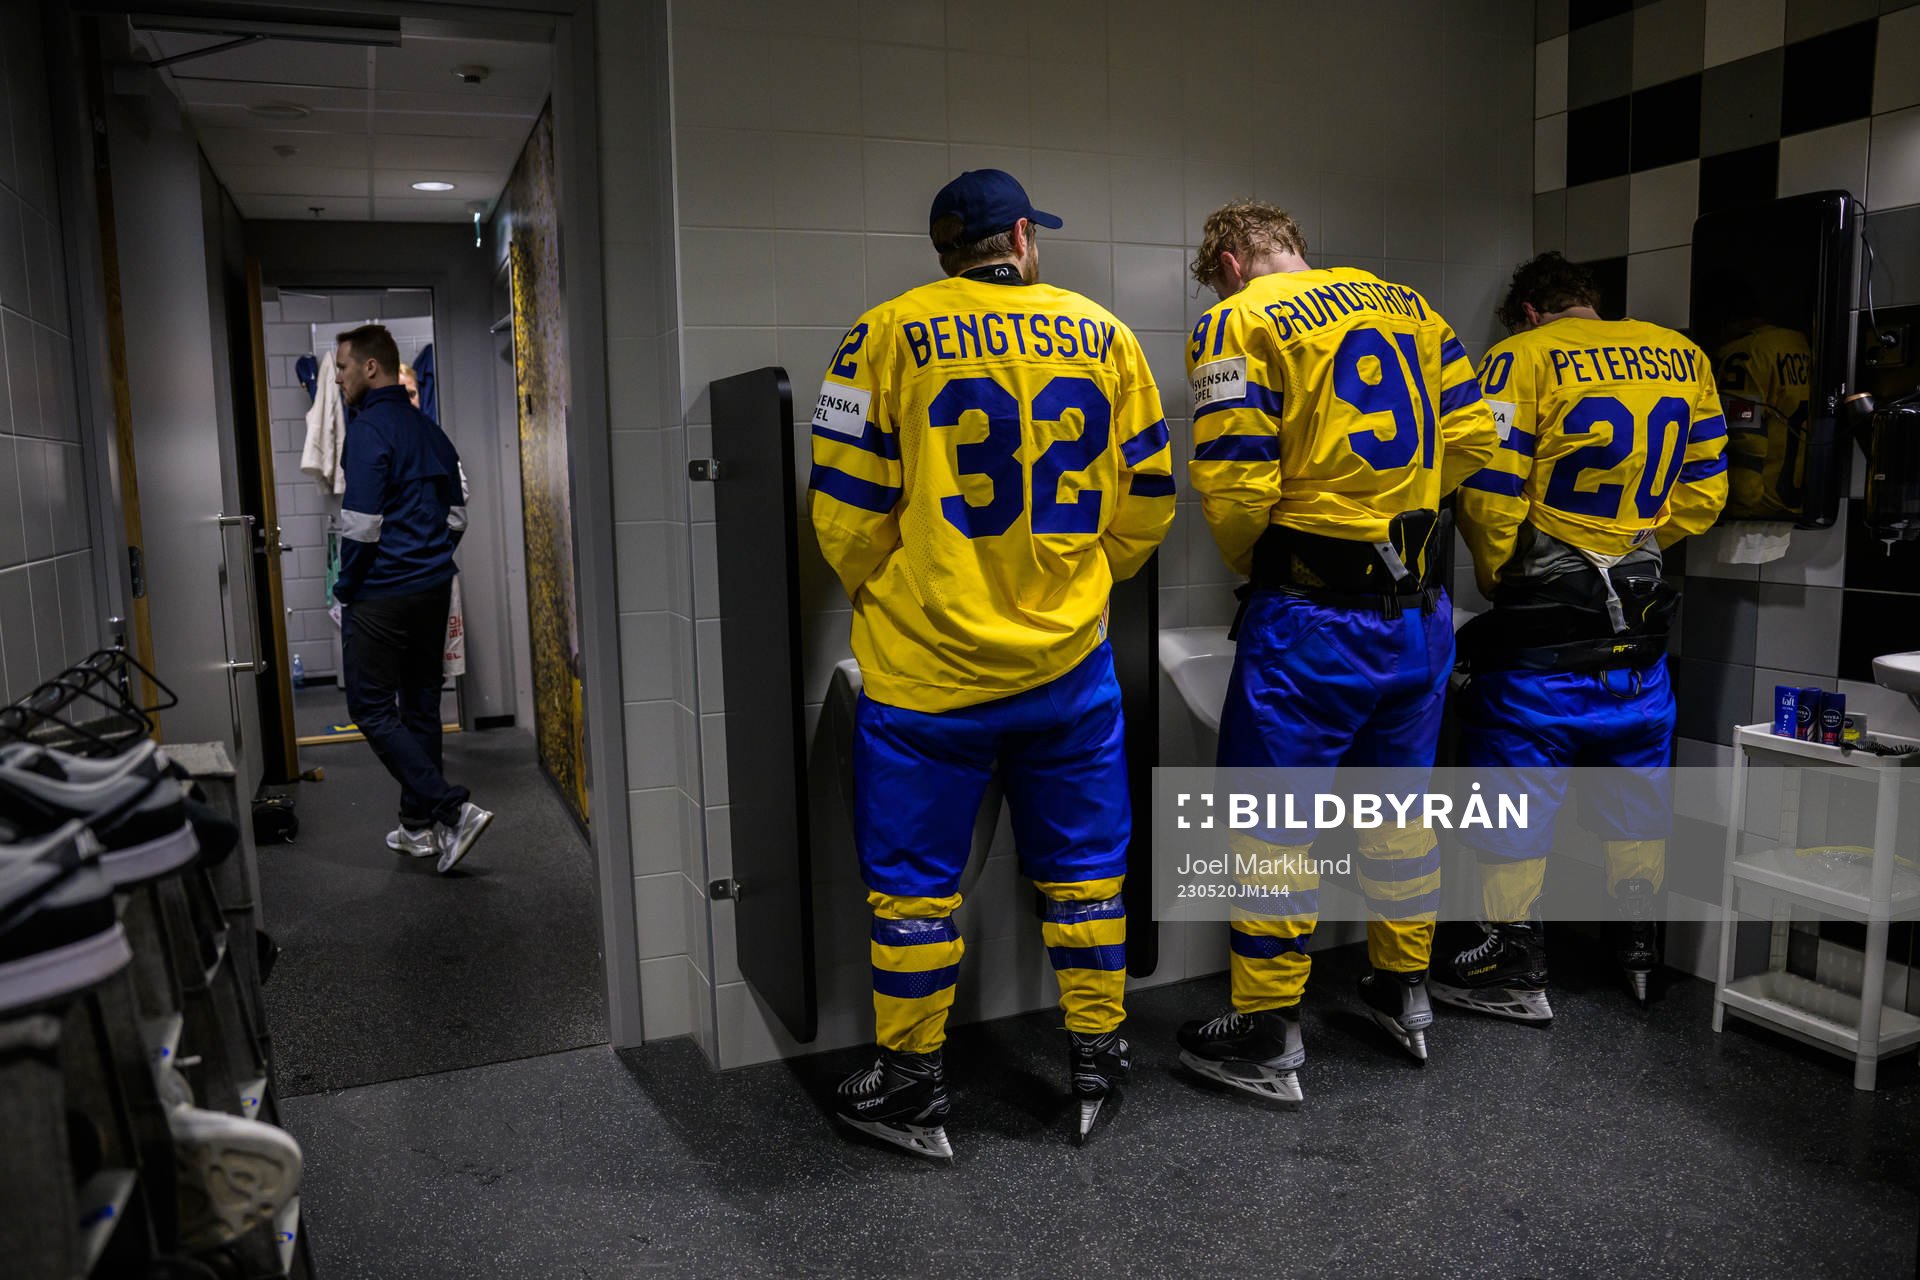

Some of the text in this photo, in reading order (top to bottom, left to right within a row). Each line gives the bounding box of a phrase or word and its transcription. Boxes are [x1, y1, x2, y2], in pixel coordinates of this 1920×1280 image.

[828, 322, 869, 380] 2
[903, 313, 1116, 368] BENGTSSON
[1192, 308, 1233, 363] 91
[1550, 346, 1697, 386] PETERSSON
[1333, 327, 1436, 471] 91
[928, 377, 1112, 539] 32
[1543, 396, 1691, 519] 20
[856, 1096, 886, 1111] CCM
